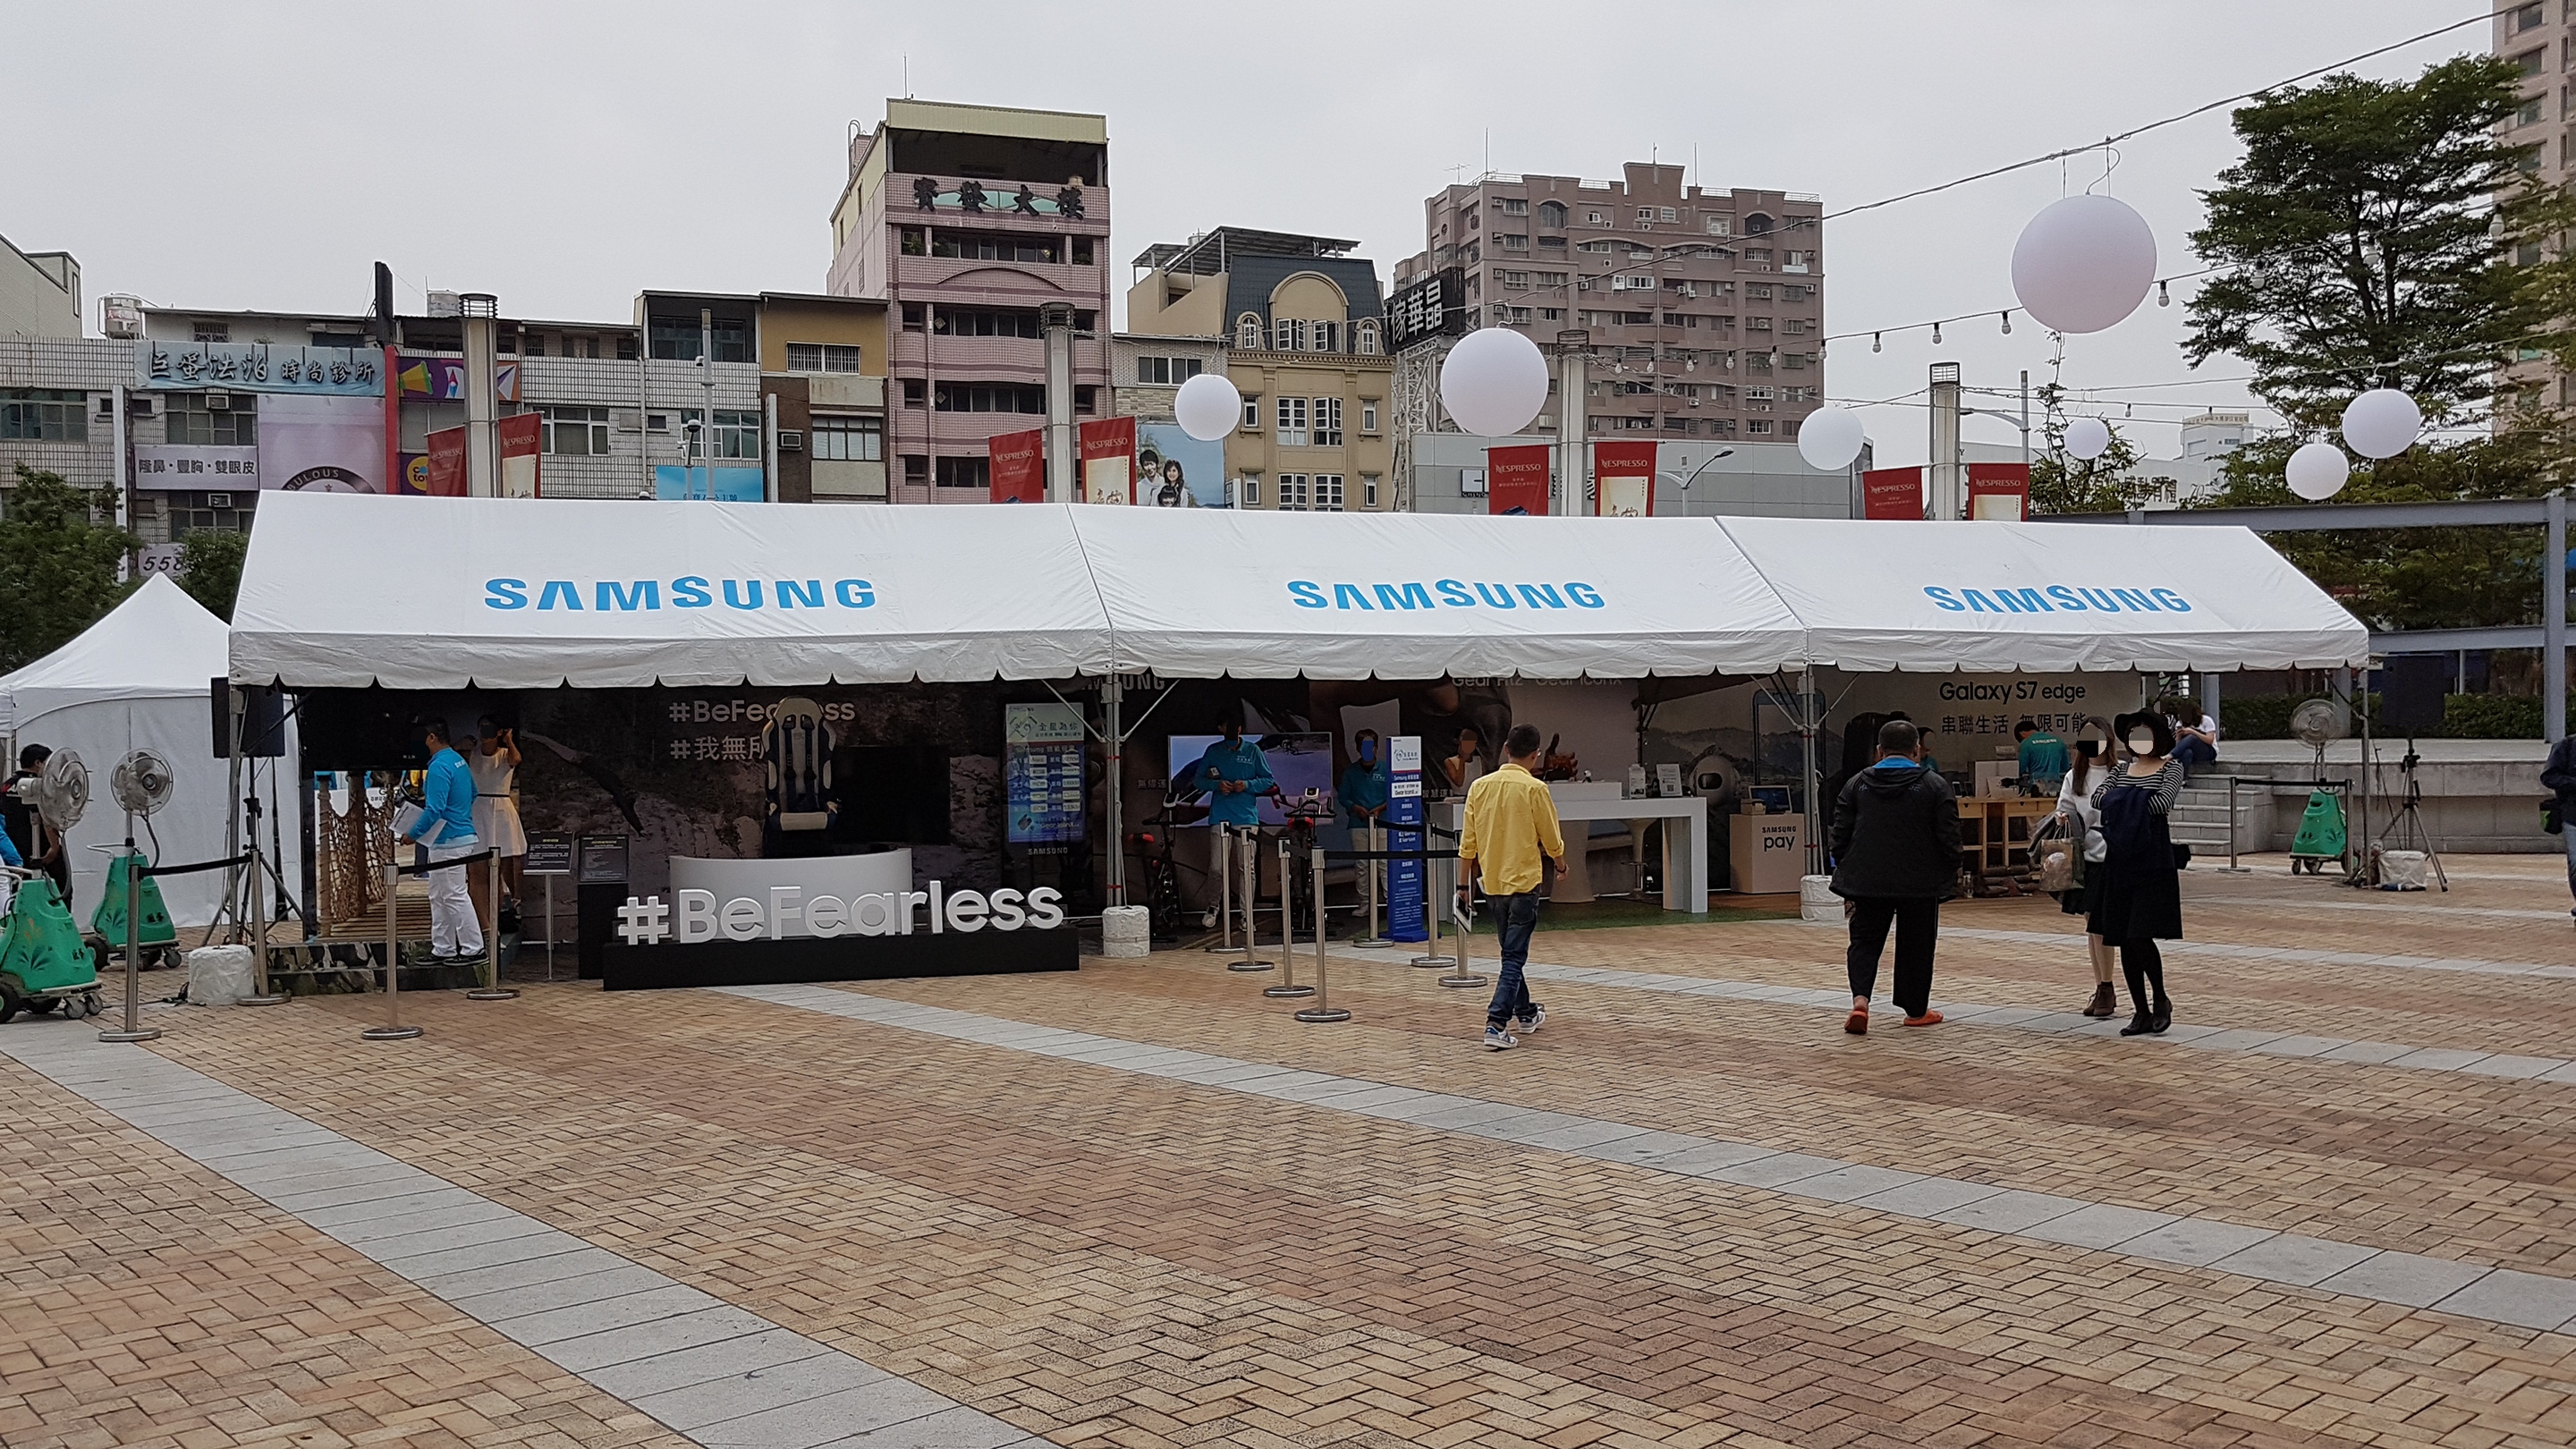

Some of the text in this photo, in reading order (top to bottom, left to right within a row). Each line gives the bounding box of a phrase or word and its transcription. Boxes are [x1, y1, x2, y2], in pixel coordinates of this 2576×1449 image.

[281, 360, 375, 386] 時尚診所
[503, 435, 536, 448] NESPRESSO
[1087, 436, 1129, 451] NESPRESSO
[431, 447, 463, 461] NESPRESSO
[995, 449, 1034, 463] NESPRESSO
[1496, 463, 1542, 474] NESPRESSO
[1600, 458, 1648, 469] NESPRESSO
[1870, 483, 1916, 495] NESPRESSO
[1975, 479, 2021, 487] NESPRESSO
[484, 576, 877, 610] SAMSUNG
[1287, 579, 1606, 610] SAMSUNG
[1923, 585, 2192, 613] SAMSUNG
[1939, 682, 2086, 705] Galaxy S7 edge
[1941, 715, 2009, 735] 串聯生活
[1761, 826, 1797, 834] SAMSUNG
[1764, 835, 1795, 852] pay
[1028, 847, 1068, 855] SAMSUNG
[617, 880, 1064, 945] #BeFearless
